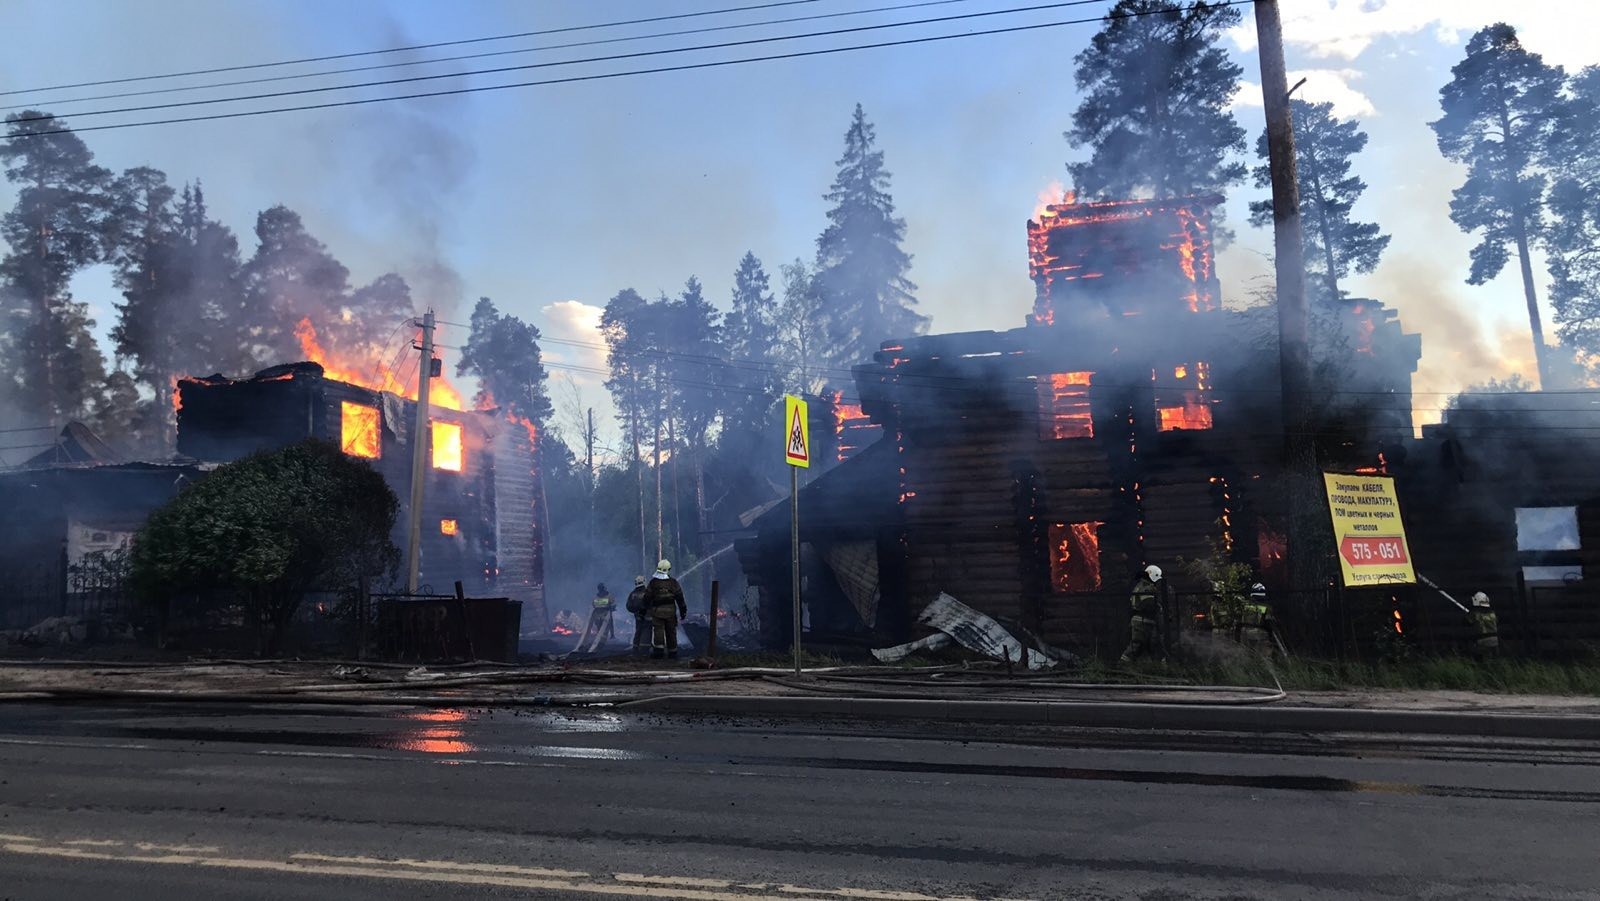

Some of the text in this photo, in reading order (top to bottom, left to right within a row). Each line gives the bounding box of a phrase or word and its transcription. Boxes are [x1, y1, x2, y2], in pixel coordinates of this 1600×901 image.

[1335, 482, 1384, 493] Закупаем КАБЕЛЯ,
[1331, 494, 1357, 506] ПРОВОДА,
[1335, 508, 1345, 517] ЛОМ
[1374, 512, 1394, 520] черных
[1352, 572, 1371, 582] Услуга
